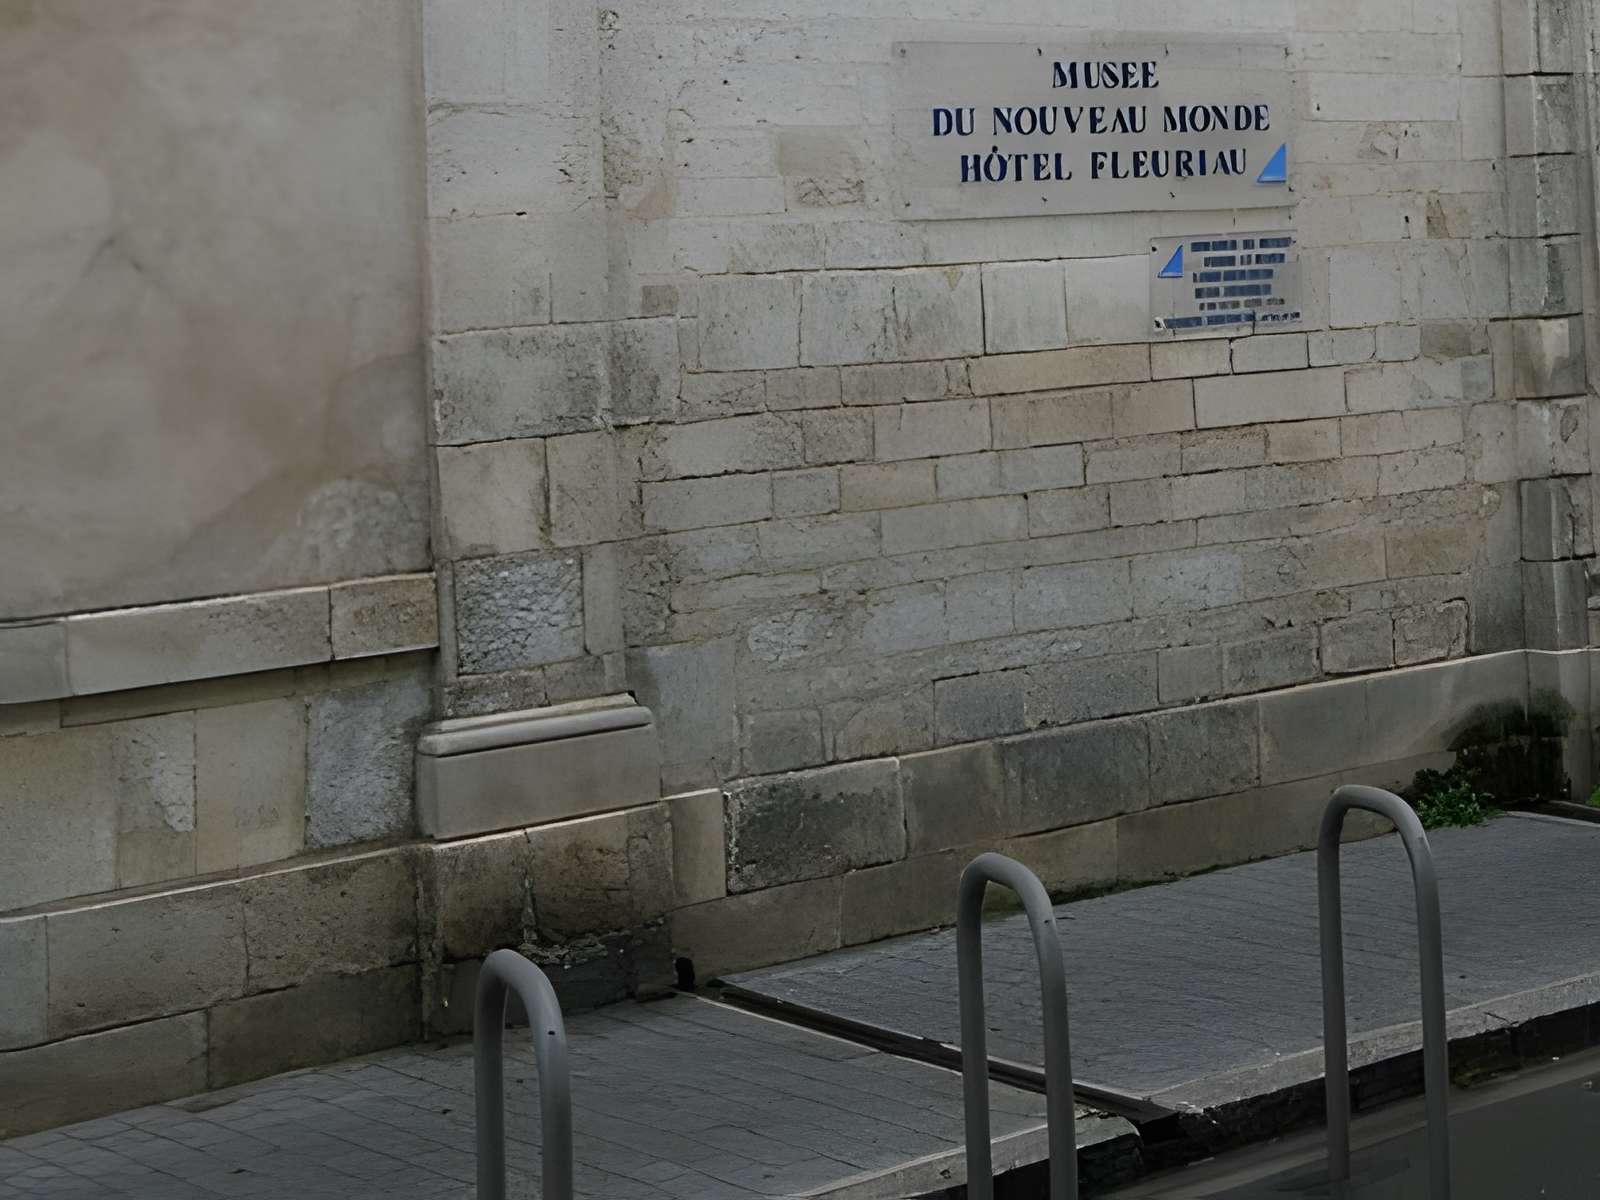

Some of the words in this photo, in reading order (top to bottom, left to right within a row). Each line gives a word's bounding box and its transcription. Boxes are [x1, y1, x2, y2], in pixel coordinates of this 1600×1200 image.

[932, 107, 976, 137] DU
[993, 105, 1147, 135] NOUVEAU
[1163, 104, 1271, 133] MONDE
[960, 145, 1073, 183] HÔTEL
[1090, 148, 1247, 179] FLEURIAU
